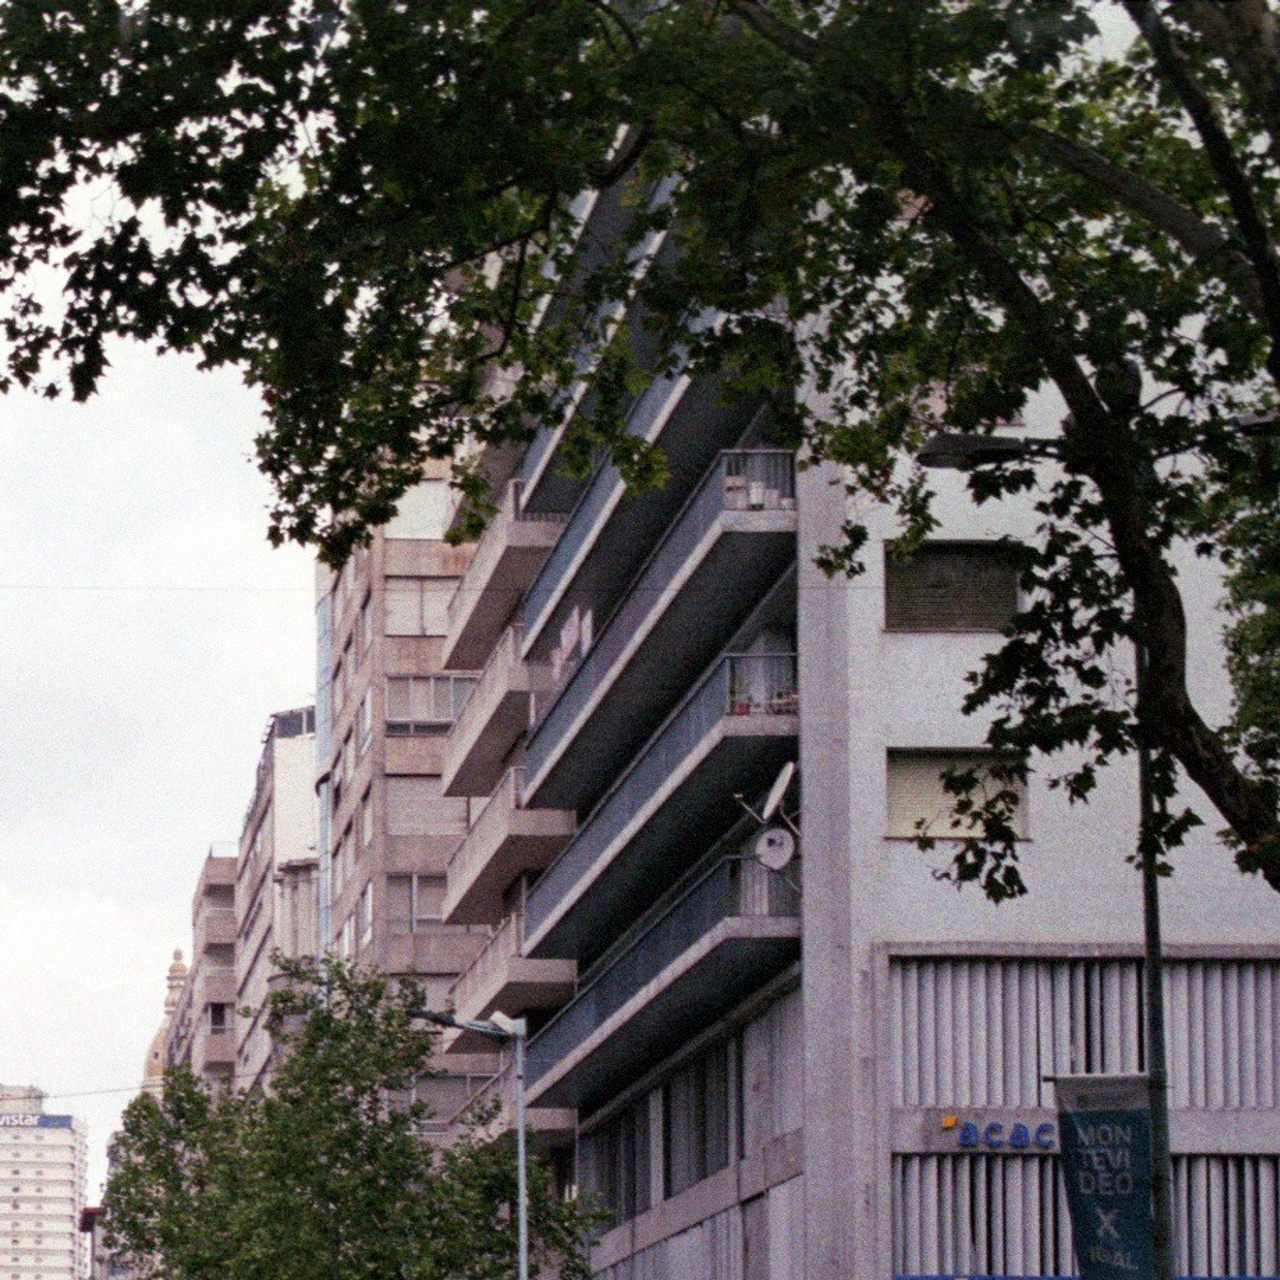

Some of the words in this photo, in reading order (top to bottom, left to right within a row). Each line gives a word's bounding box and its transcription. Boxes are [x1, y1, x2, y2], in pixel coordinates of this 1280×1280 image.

[957, 1119, 1057, 1148] acac
[1078, 1125, 1132, 1146] MON
[1081, 1149, 1131, 1171] TEVI
[1079, 1172, 1133, 1196] DEO
[1095, 1206, 1120, 1239] X
